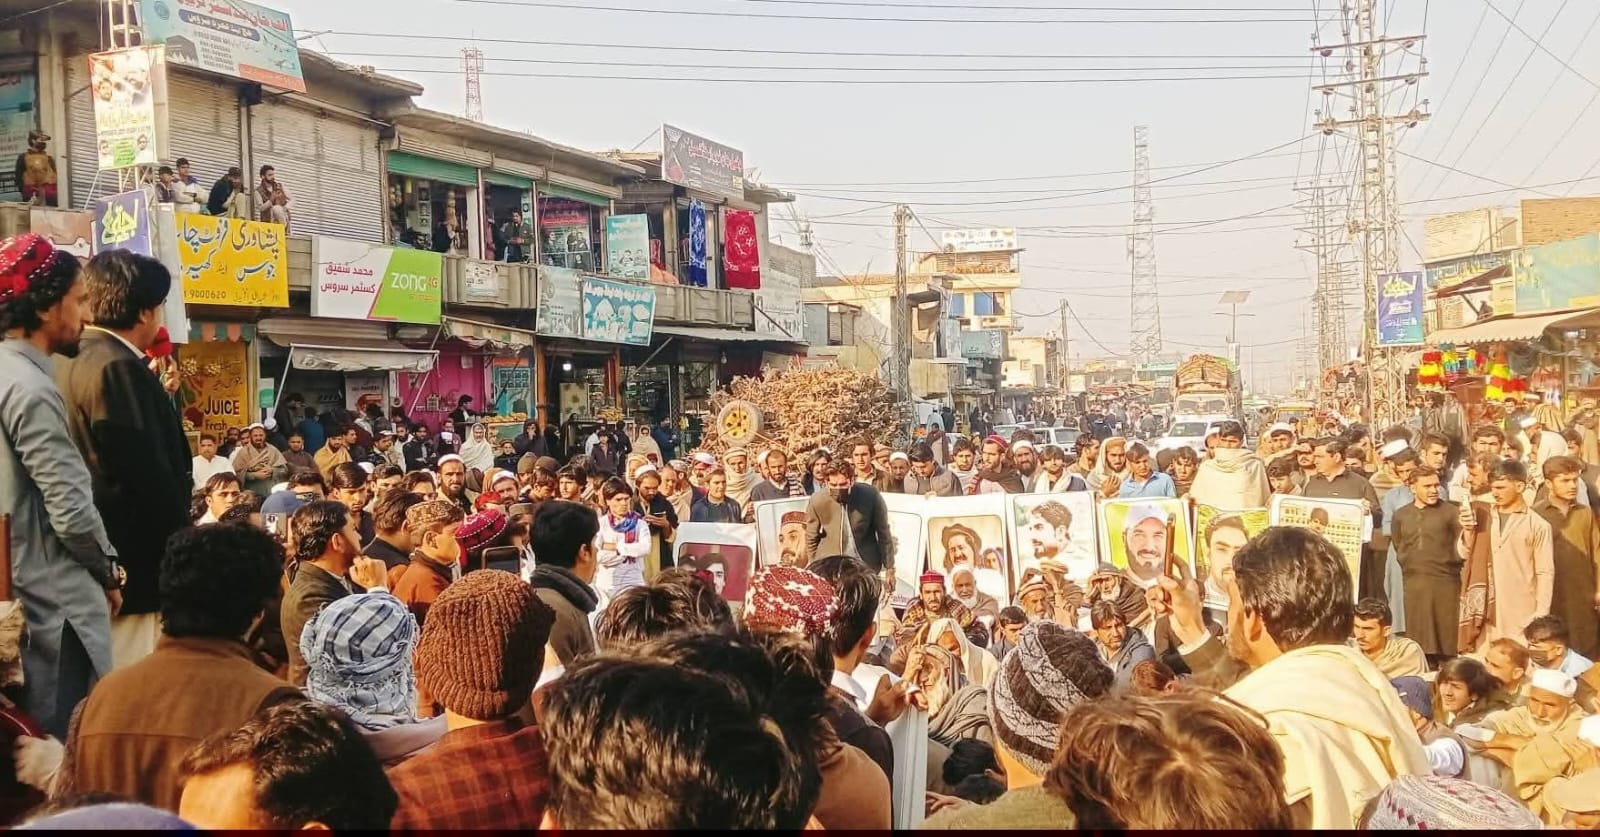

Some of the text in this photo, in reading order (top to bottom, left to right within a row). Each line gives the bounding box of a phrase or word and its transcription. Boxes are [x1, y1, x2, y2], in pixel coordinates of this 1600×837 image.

[176, 216, 198, 253] چا
[231, 222, 279, 260] پشاوری
[236, 260, 276, 282] جوس
[326, 261, 374, 276] محمد شفیق
[320, 281, 376, 294] کسٹمر سروس
[391, 272, 427, 292] ZONG
[204, 396, 240, 415] JUICE
[205, 419, 228, 431] Fresh
